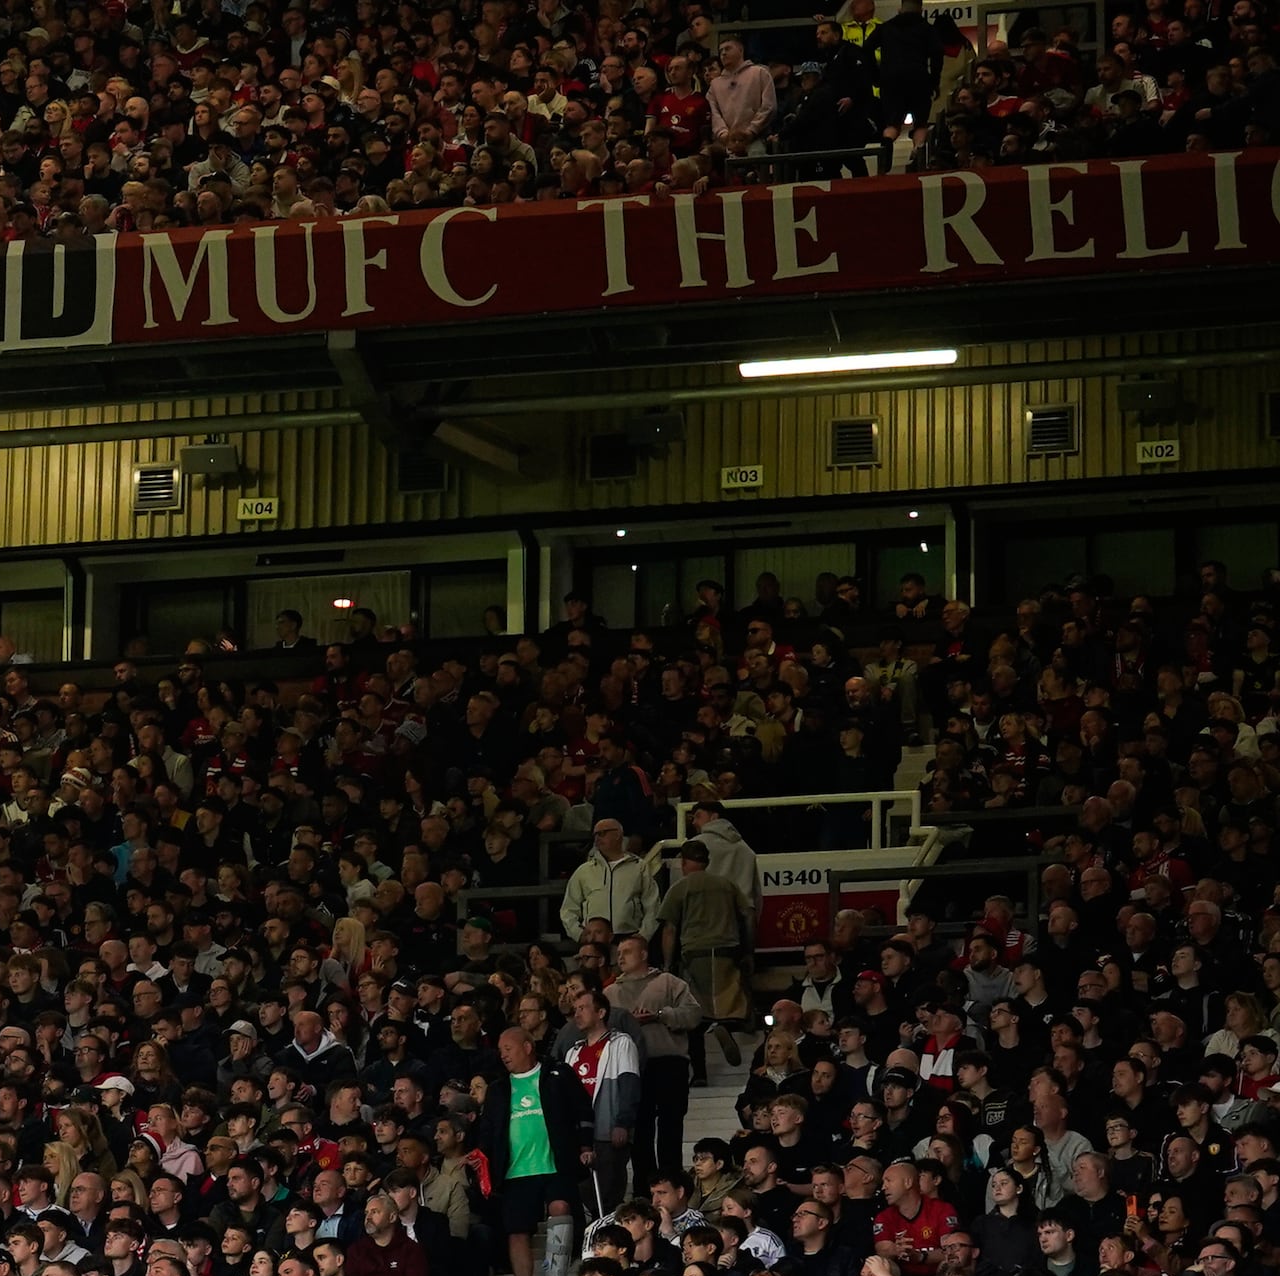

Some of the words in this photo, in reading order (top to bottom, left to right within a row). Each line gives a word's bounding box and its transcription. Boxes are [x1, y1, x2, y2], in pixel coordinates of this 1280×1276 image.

[140, 207, 497, 329] MUFC
[576, 180, 838, 297] THE
[919, 150, 1280, 274] RELI
[1142, 444, 1174, 458] N02
[726, 470, 758, 483] N03
[242, 502, 272, 515] N04
